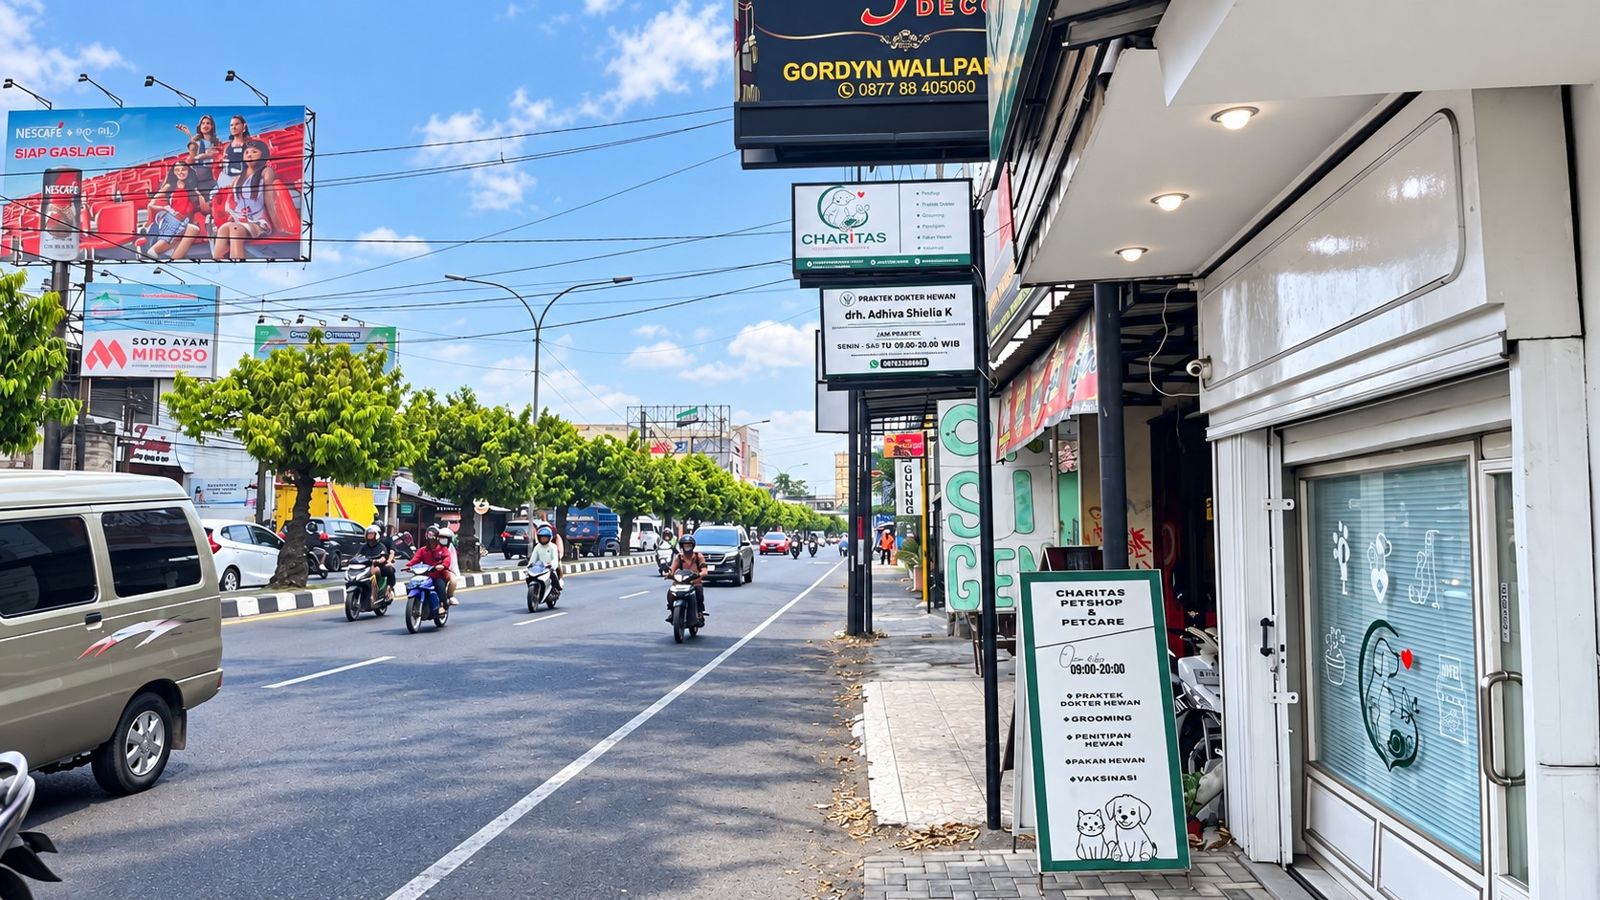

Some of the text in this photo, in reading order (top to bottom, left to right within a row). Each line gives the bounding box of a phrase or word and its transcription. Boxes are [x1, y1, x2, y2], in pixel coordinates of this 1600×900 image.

[916, 0, 987, 17] DEC
[783, 61, 881, 82] GORDYN
[859, 79, 976, 97] 0877 88 405060
[15, 147, 47, 160] SIAP
[858, 293, 956, 302] PRAKTEK DOKTER HEWAN
[845, 306, 952, 320] drh. Adhiva Shielia K
[132, 337, 209, 347] SOTO AYAM
[837, 342, 860, 350] SENIN
[941, 339, 960, 348] WIB
[132, 348, 208, 362] MIROSO
[1056, 588, 1126, 597] CHARITAS
[1060, 599, 1123, 608] PETSHOP
[1087, 608, 1097, 617] &
[1061, 618, 1125, 627] PETCARE
[1070, 663, 1126, 675] 09:00-20:00
[1071, 714, 1132, 722] GROOMING
[1075, 732, 1132, 740] PENITIPAN
[1085, 740, 1124, 748] HEWAN
[1077, 774, 1137, 782] VAKSINASI
